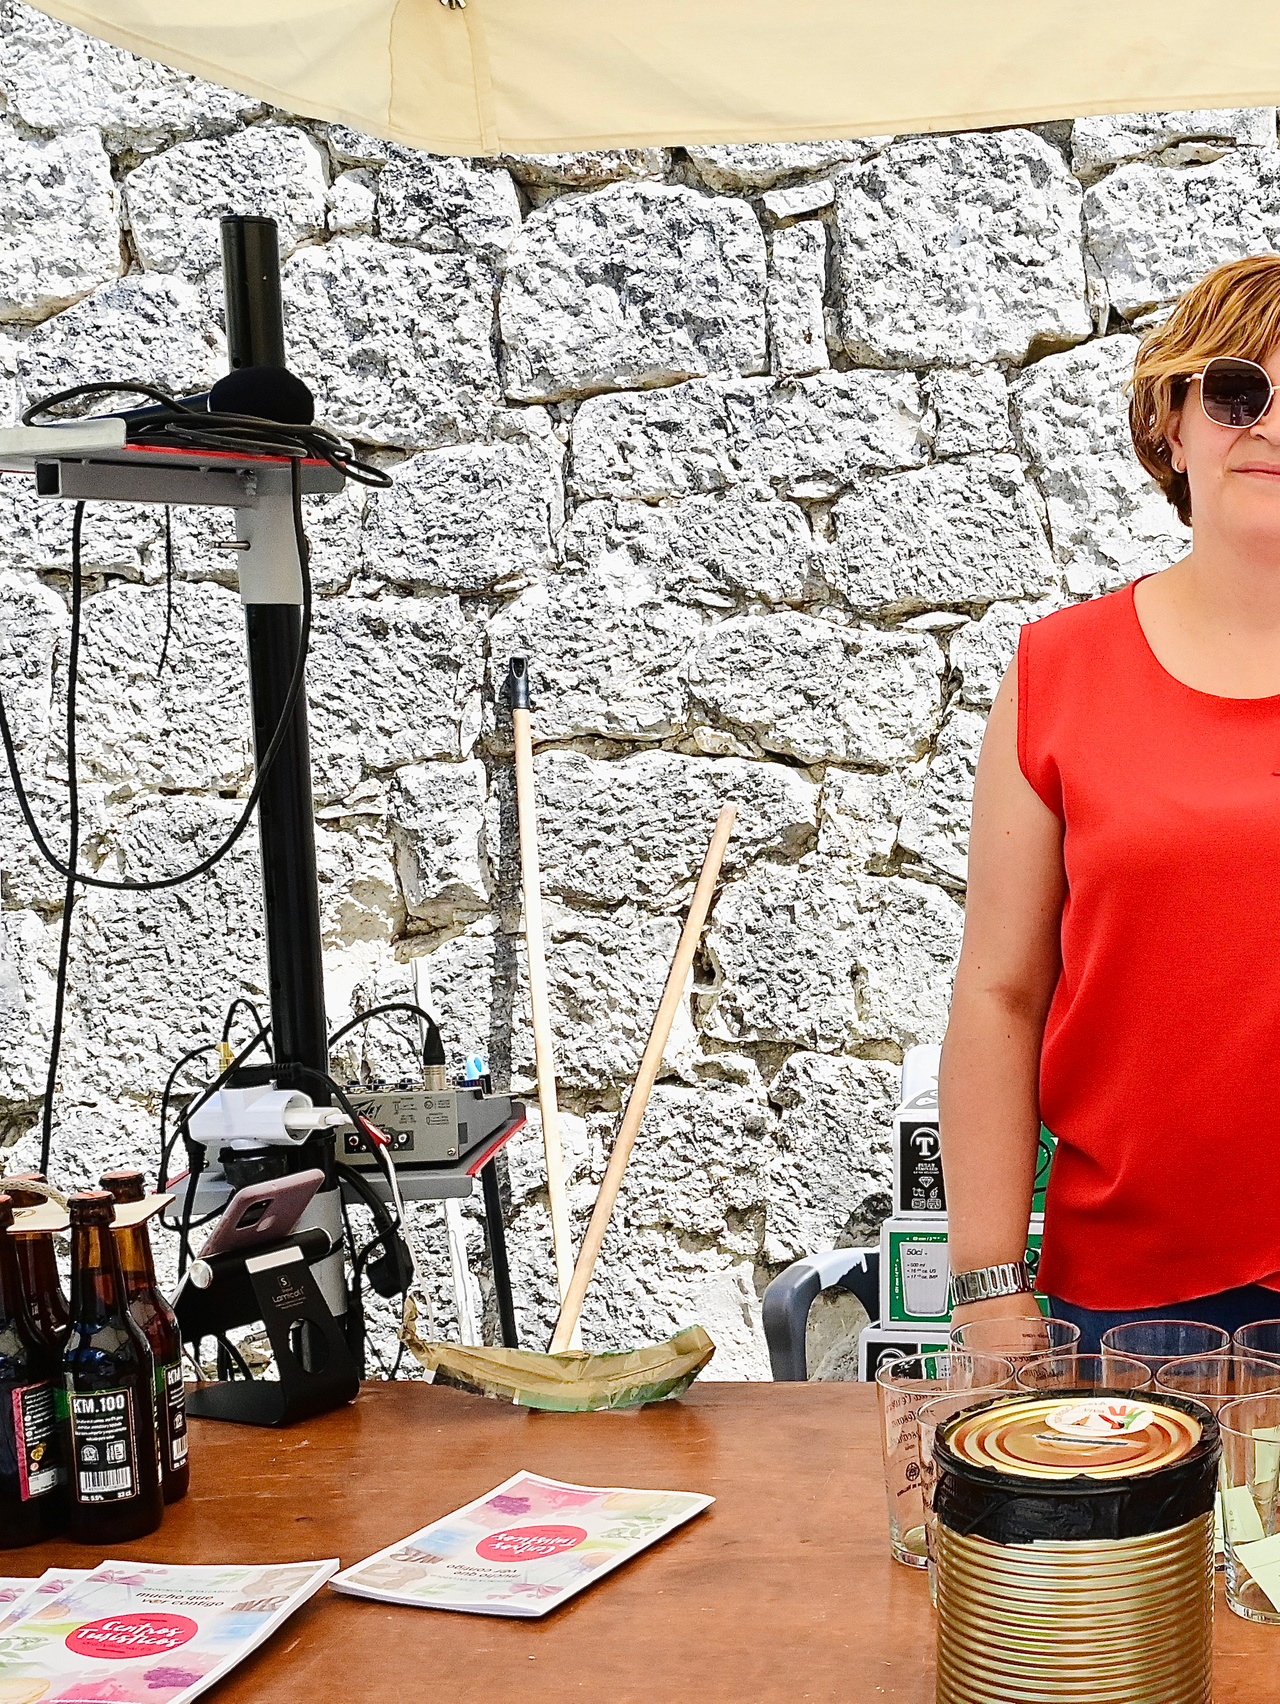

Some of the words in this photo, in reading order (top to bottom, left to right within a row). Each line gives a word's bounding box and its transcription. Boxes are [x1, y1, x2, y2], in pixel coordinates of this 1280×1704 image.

[73, 1394, 125, 1414] KM.100
[446, 1564, 492, 1572] contigo
[136, 1592, 184, 1600] mucho
[187, 1594, 214, 1602] que
[171, 1599, 225, 1608] contigo
[101, 1620, 185, 1637] Centros
